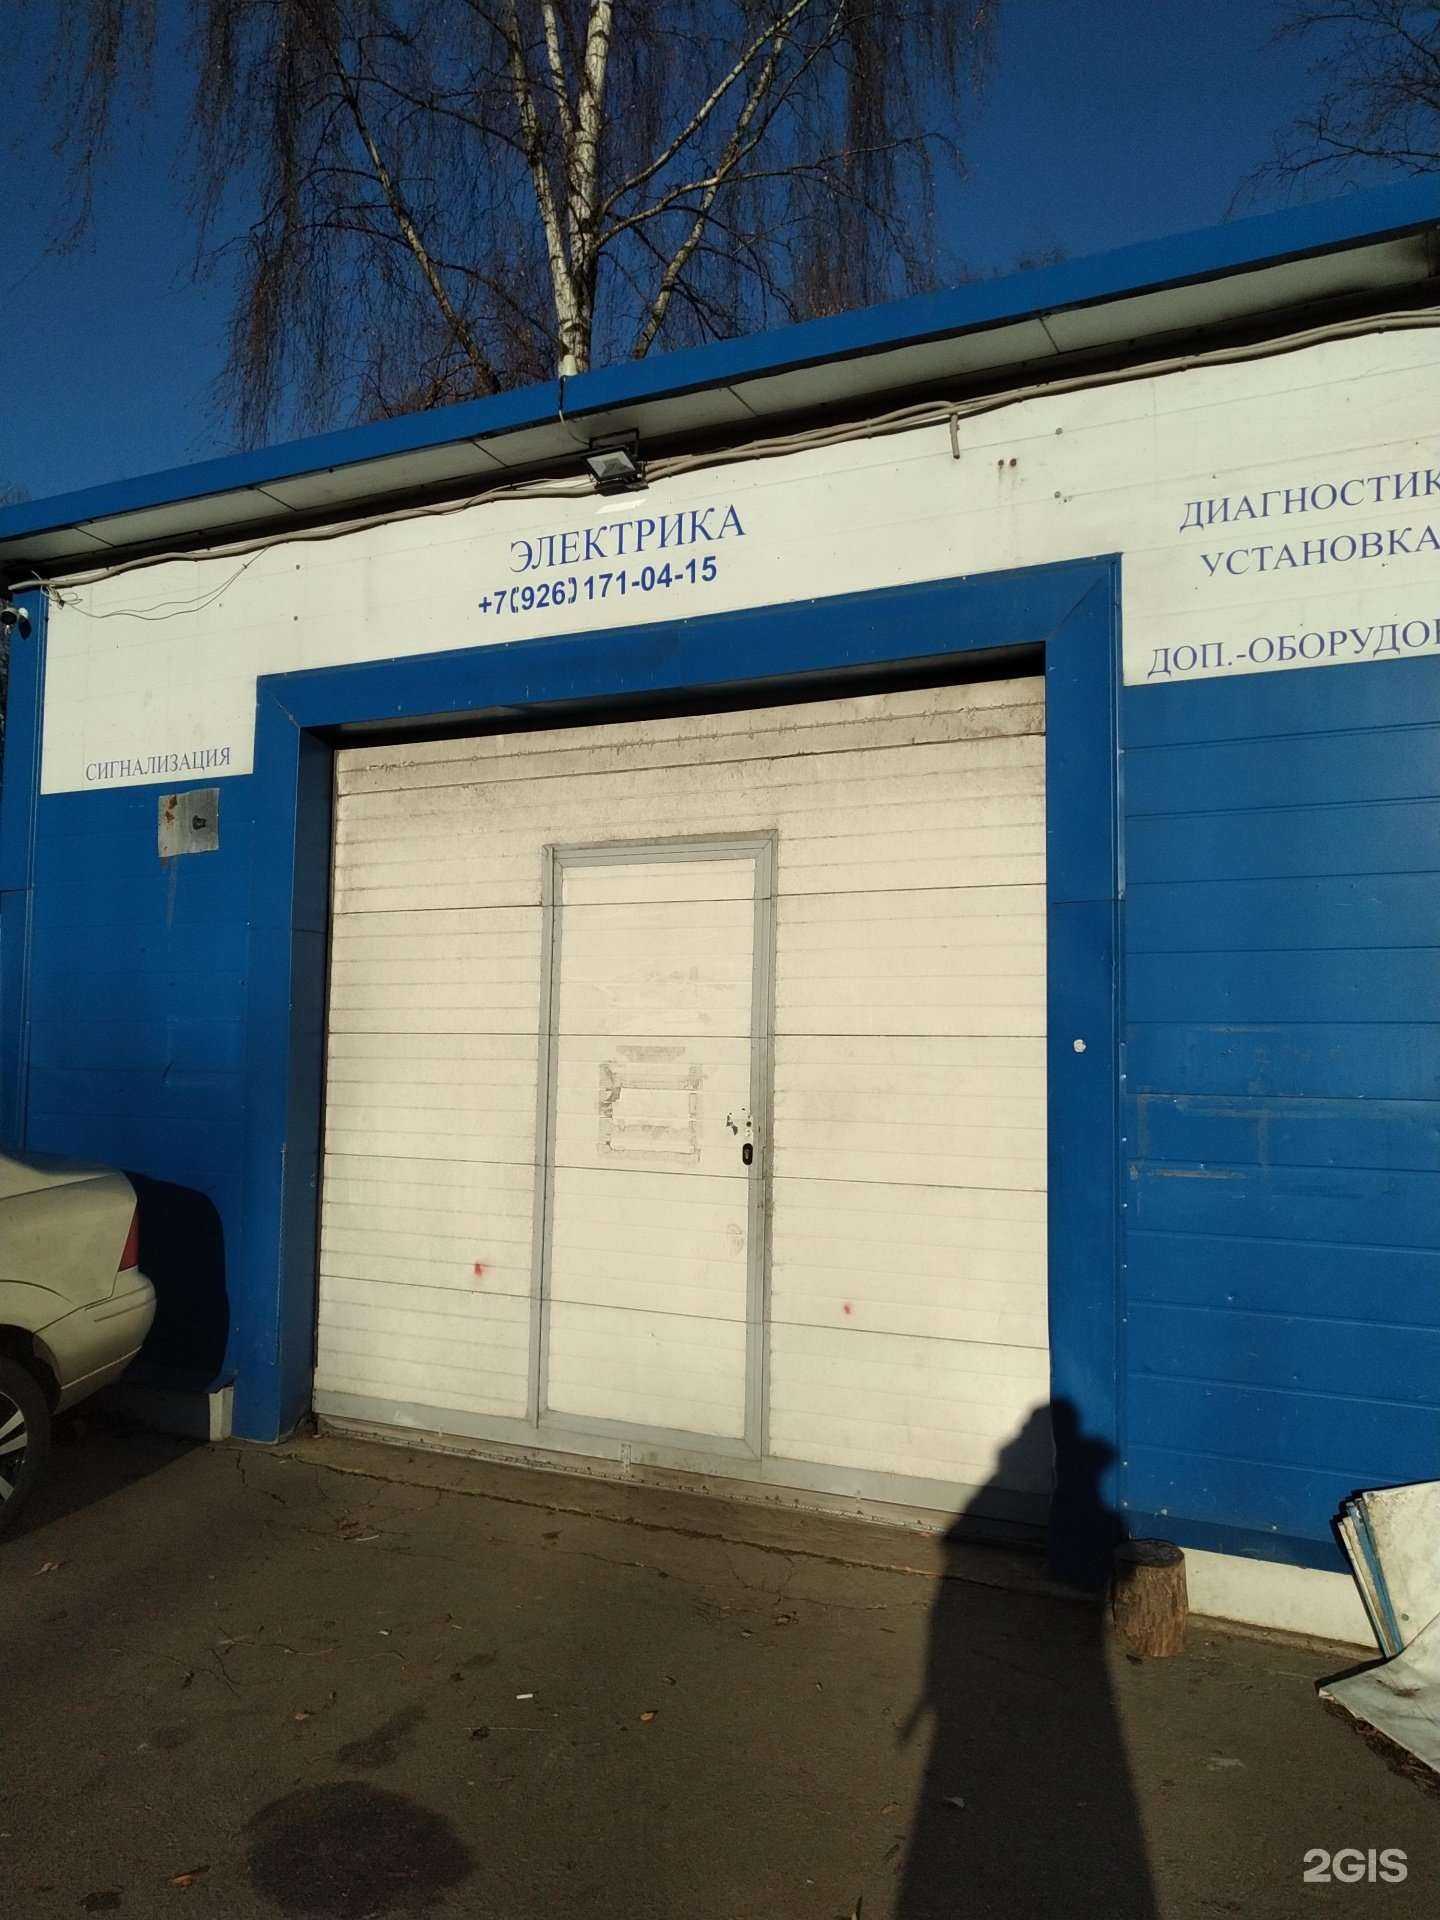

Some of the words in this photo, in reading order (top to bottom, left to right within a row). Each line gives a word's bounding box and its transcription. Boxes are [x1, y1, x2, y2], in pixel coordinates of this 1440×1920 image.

[1180, 469, 1440, 532] ДИАГНОСТИК
[510, 504, 745, 572] ЭЛЕКТРИКА
[1200, 525, 1440, 577] УСТАНОВКА
[86, 747, 230, 780] СИГНАЛИЗАЦИЯ
